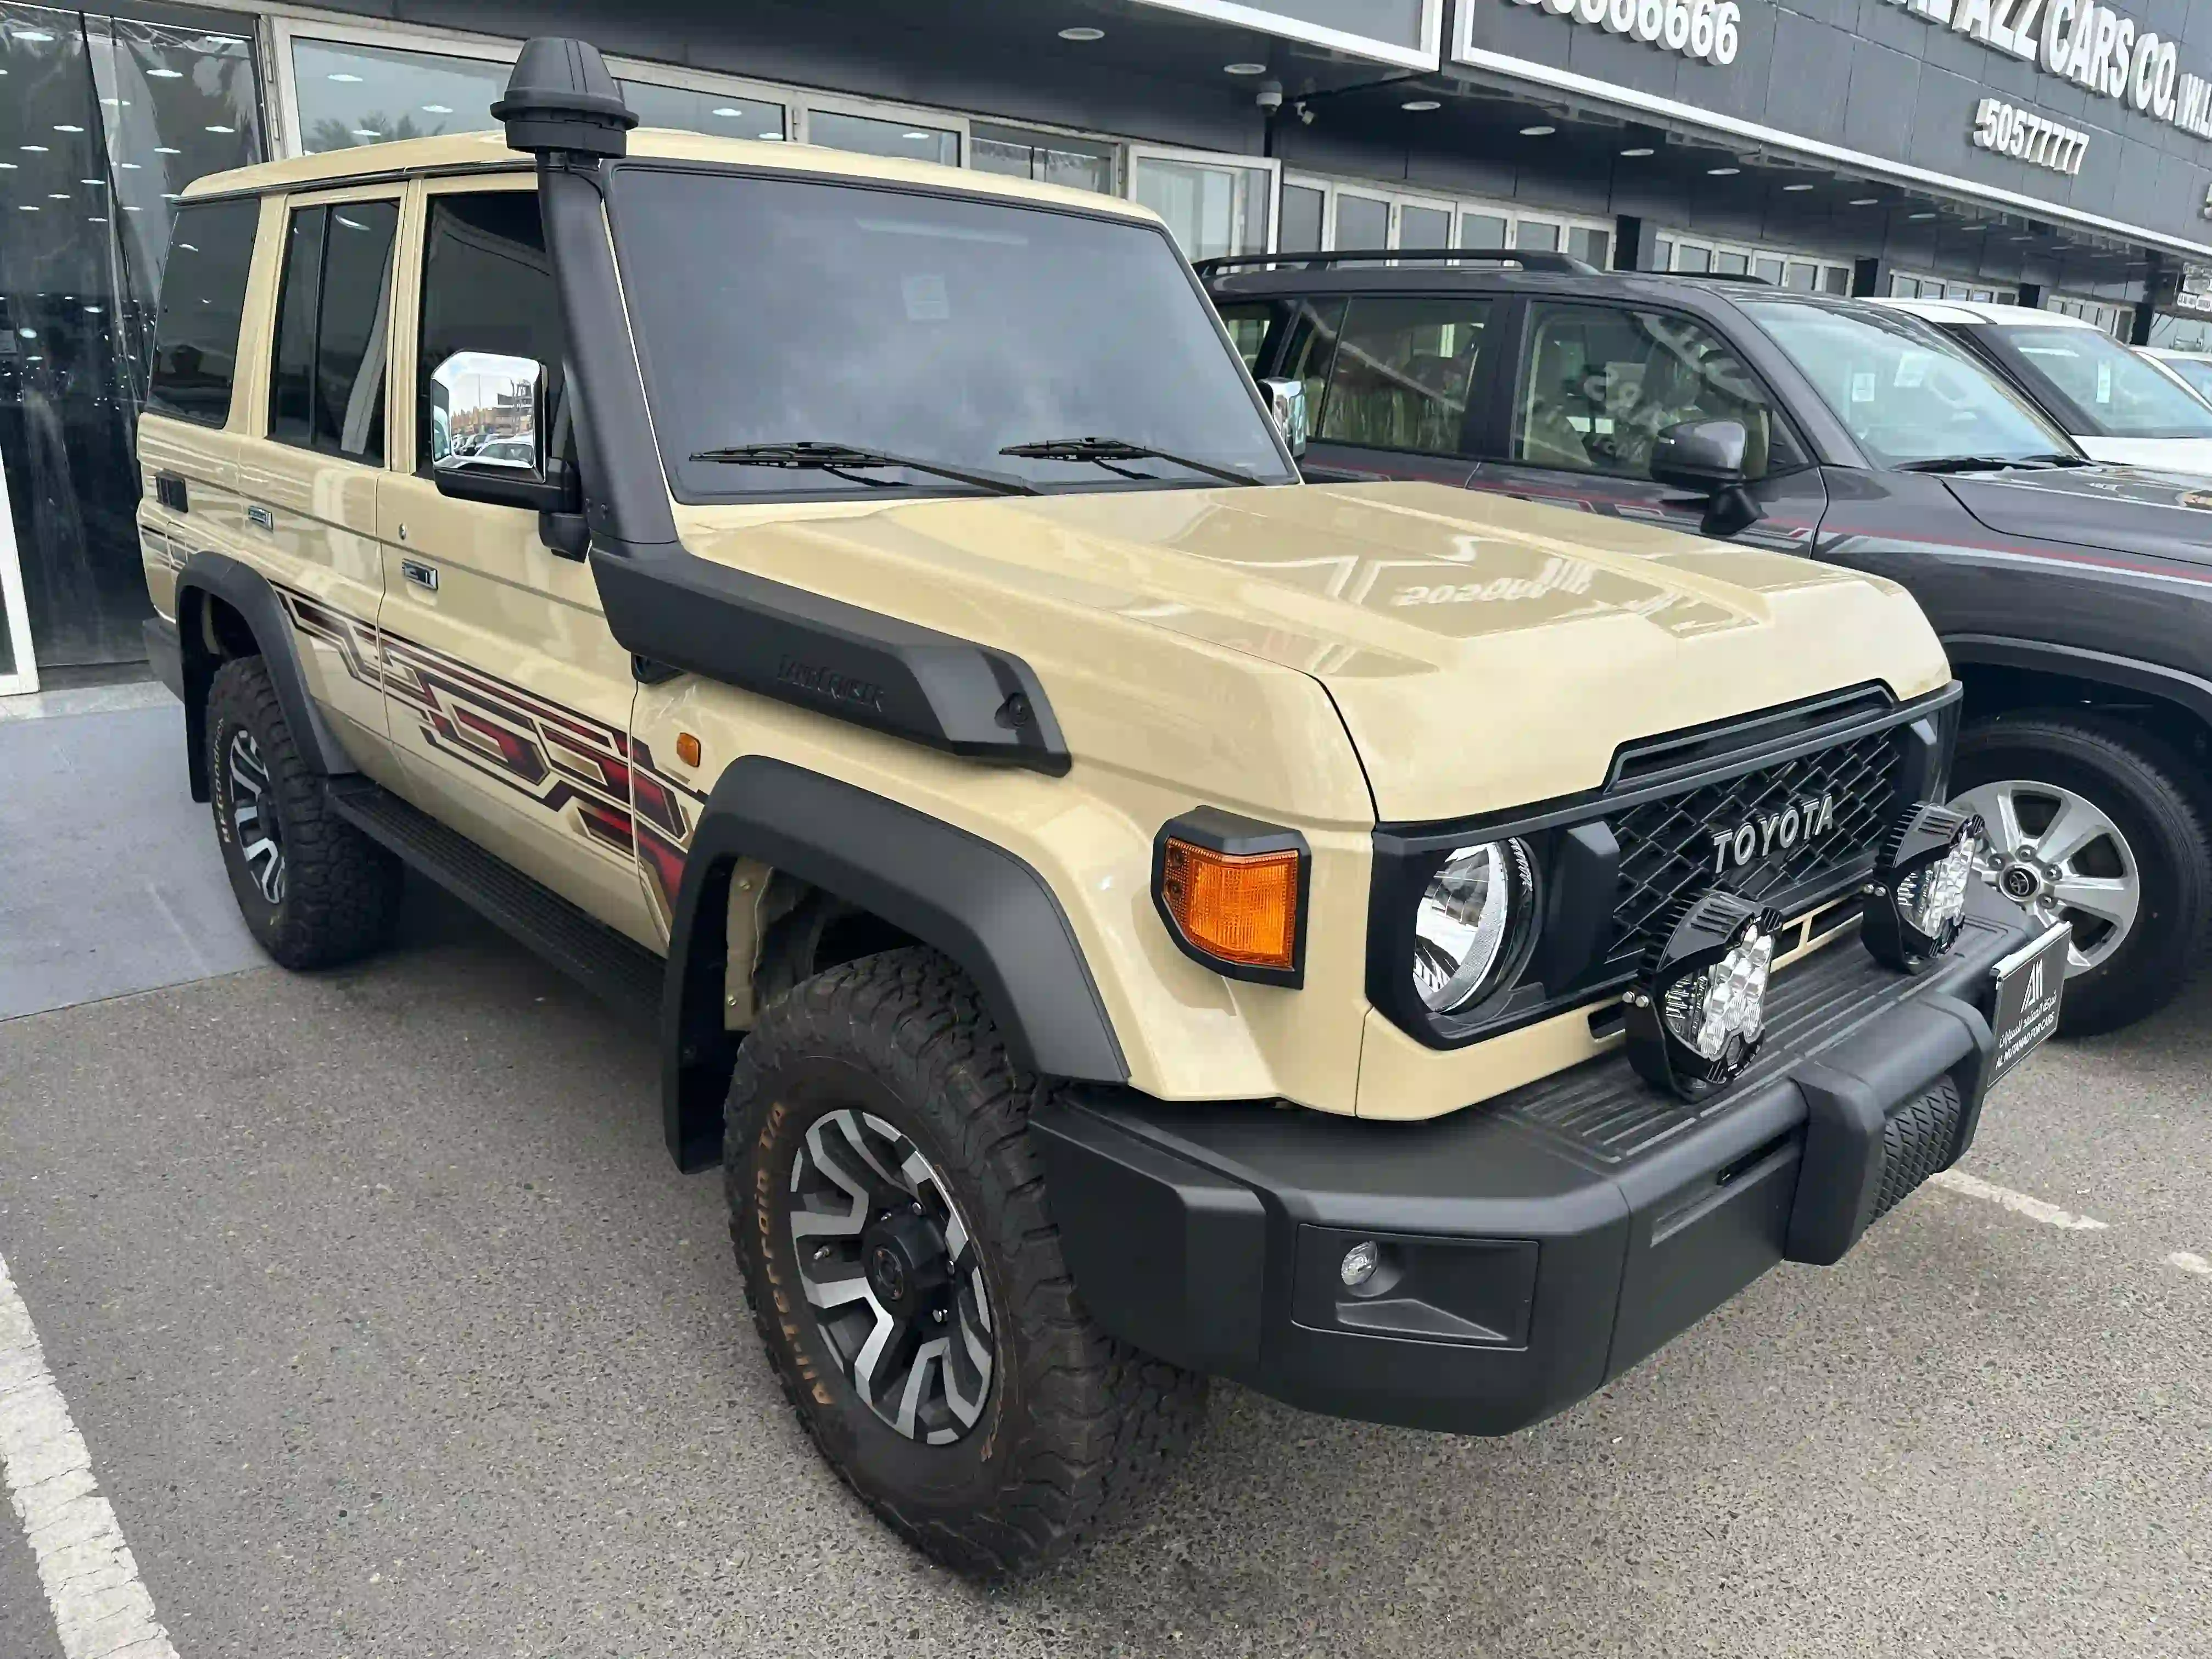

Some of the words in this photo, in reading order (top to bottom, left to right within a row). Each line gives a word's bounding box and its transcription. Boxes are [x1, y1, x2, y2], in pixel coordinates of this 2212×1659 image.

[2043, 0, 2135, 98] CARS
[2132, 32, 2176, 121] CO.
[1978, 98, 2090, 175] 50577777
[1712, 794, 1833, 874] TOYOTA
[1999, 1019, 2023, 1048] للسيارات
[2043, 988, 2057, 1012] شركة
[1995, 1055, 2003, 1070] AL
[2030, 1023, 2041, 1040] FOR
[2041, 1011, 2055, 1031] CARS
